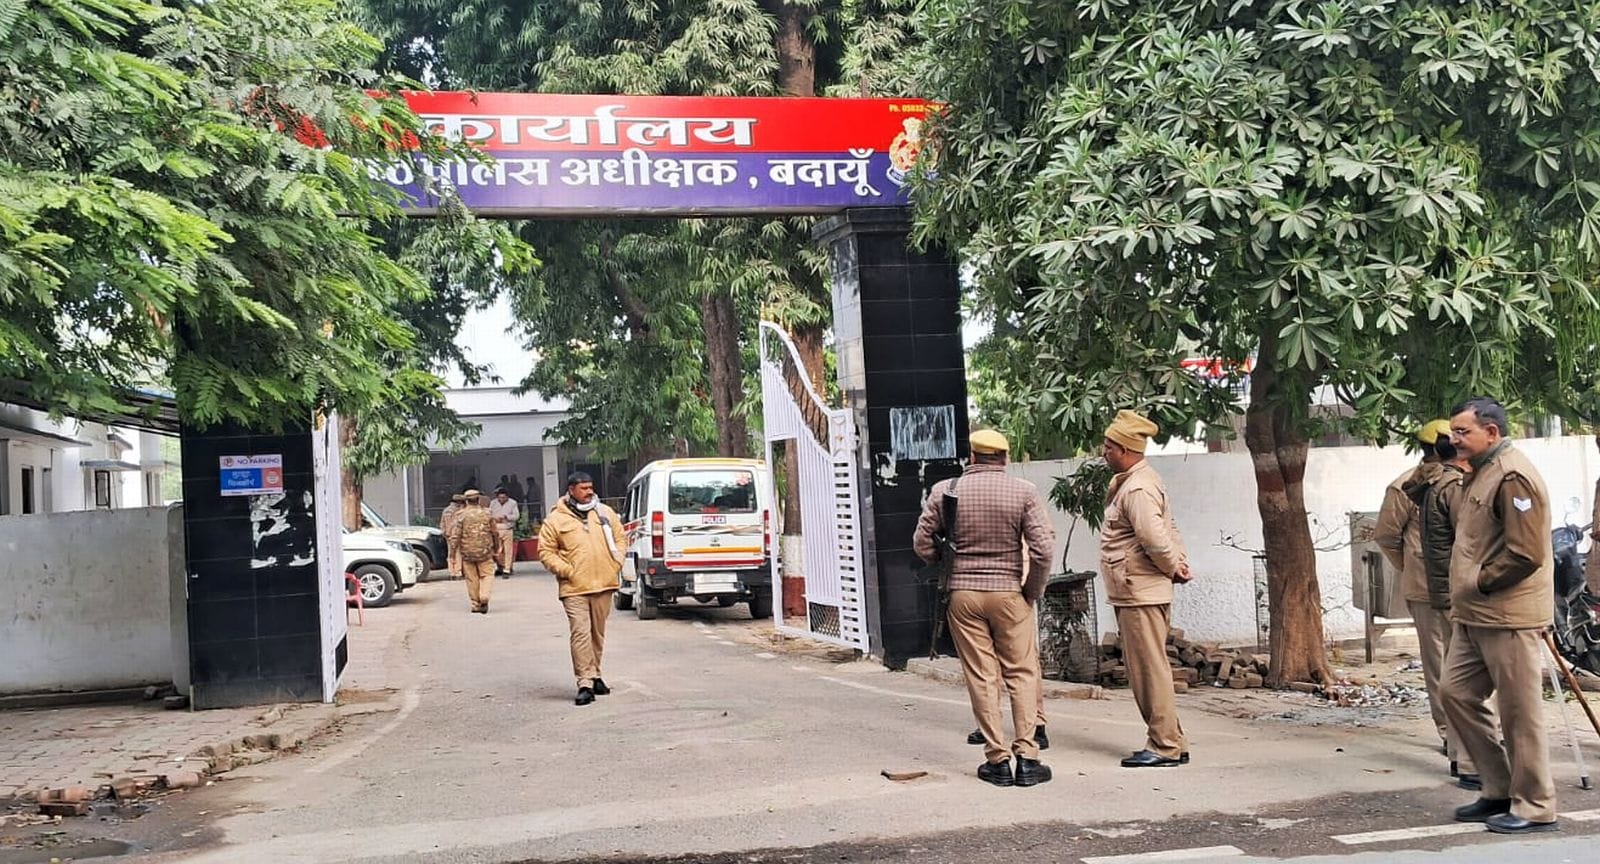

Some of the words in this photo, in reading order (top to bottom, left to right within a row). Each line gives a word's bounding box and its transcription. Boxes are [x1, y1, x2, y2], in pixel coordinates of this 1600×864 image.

[421, 105, 758, 147] कार्यालय
[561, 148, 738, 188] अधीक्षक
[768, 148, 882, 197] बदायूँ
